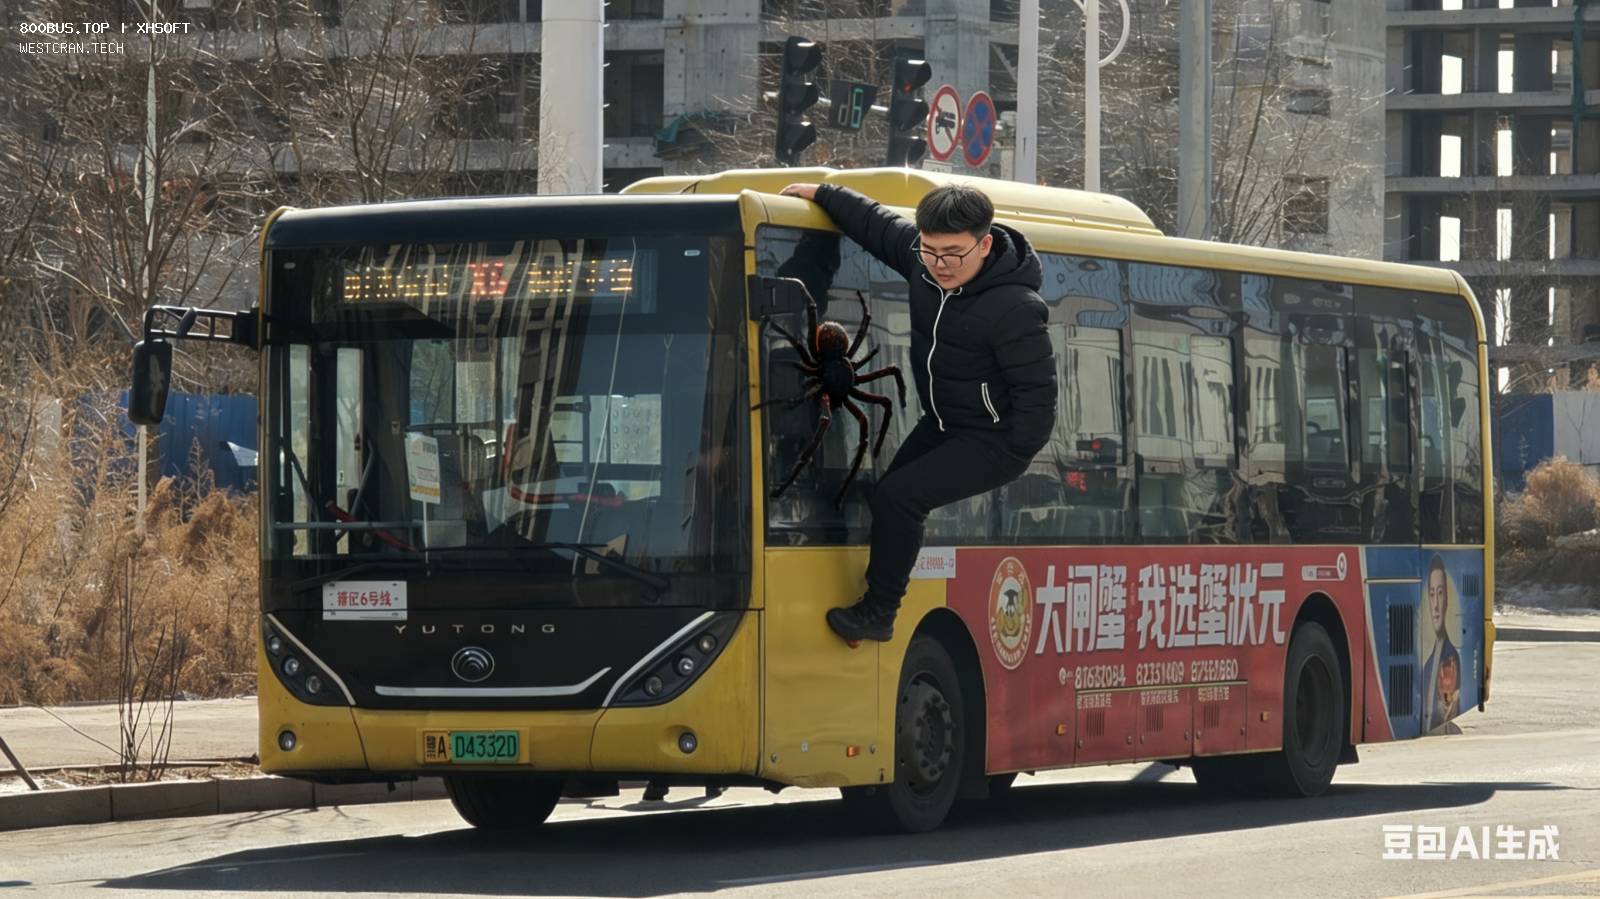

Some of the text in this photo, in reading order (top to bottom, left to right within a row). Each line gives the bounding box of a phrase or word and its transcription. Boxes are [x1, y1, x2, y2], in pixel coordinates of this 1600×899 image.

[394, 624, 556, 634] YUTONG
[1034, 564, 1127, 655] 大闸蟹
[1137, 562, 1287, 650] 我选蟹状元
